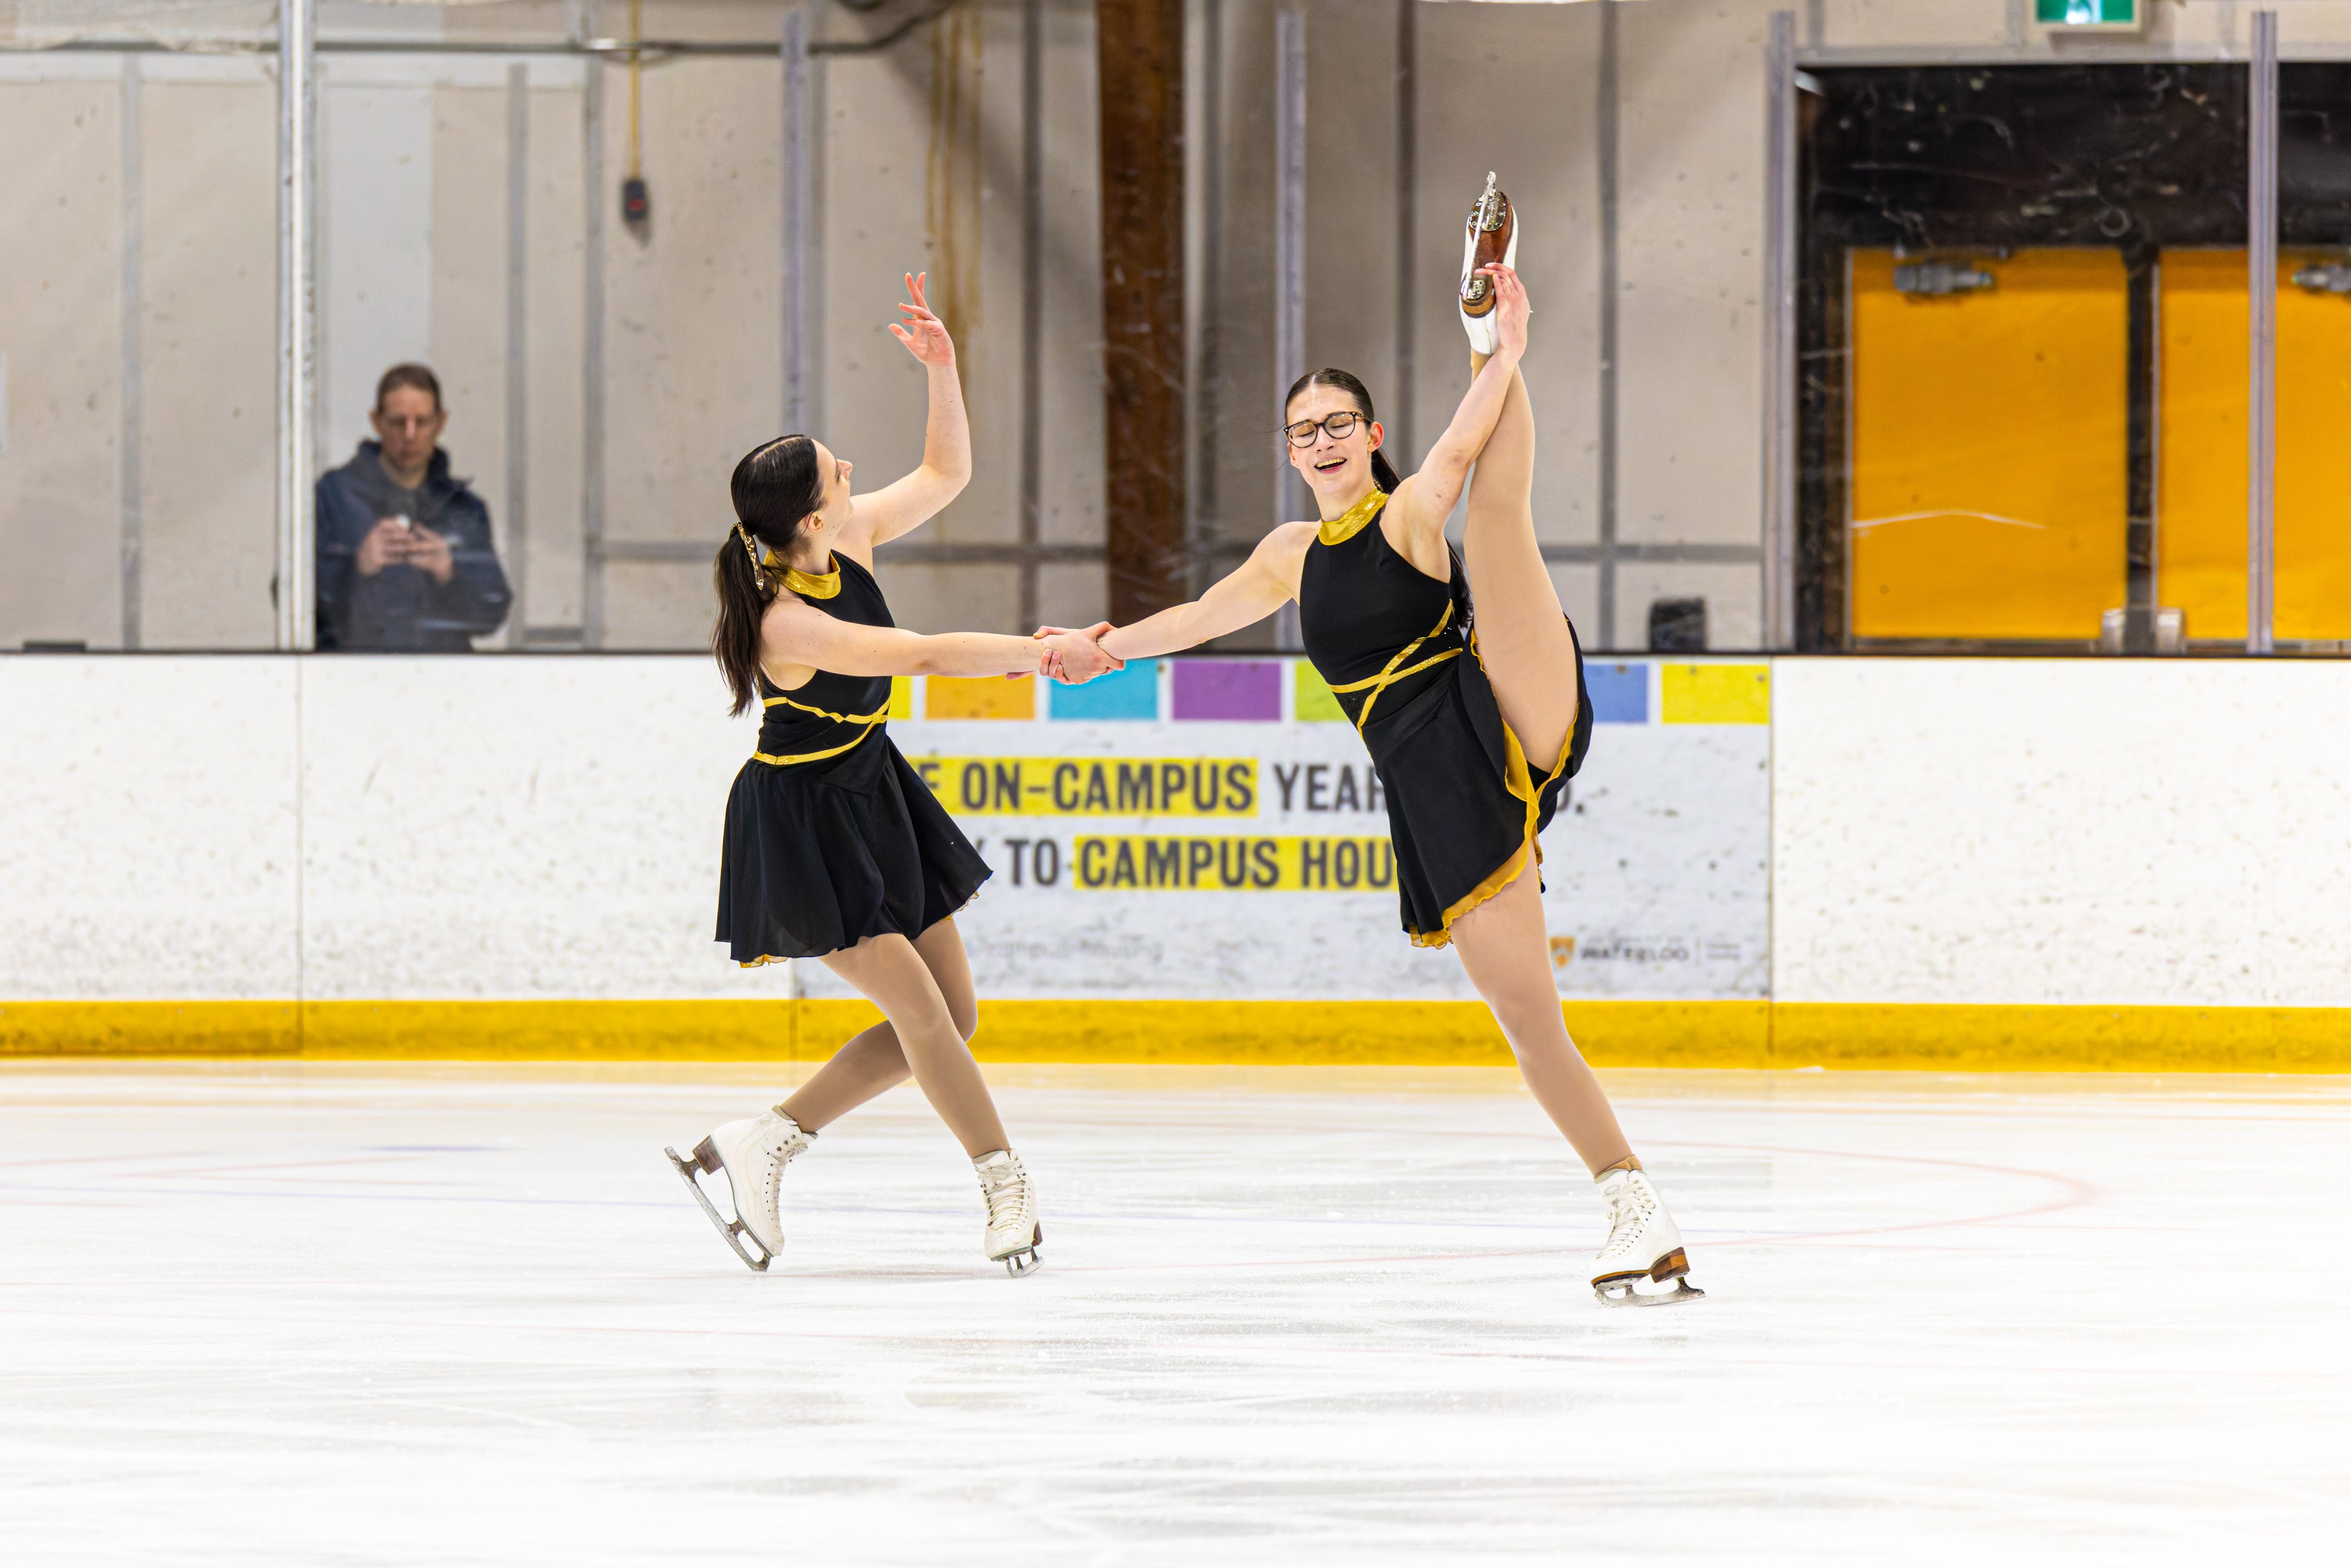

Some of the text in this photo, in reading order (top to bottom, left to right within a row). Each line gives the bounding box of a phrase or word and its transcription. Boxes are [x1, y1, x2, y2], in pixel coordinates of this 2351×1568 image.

[961, 761, 1252, 811] ON-CAMPUS
[1004, 838, 1059, 887] TO
[1080, 840, 1280, 888] CAMPUS
